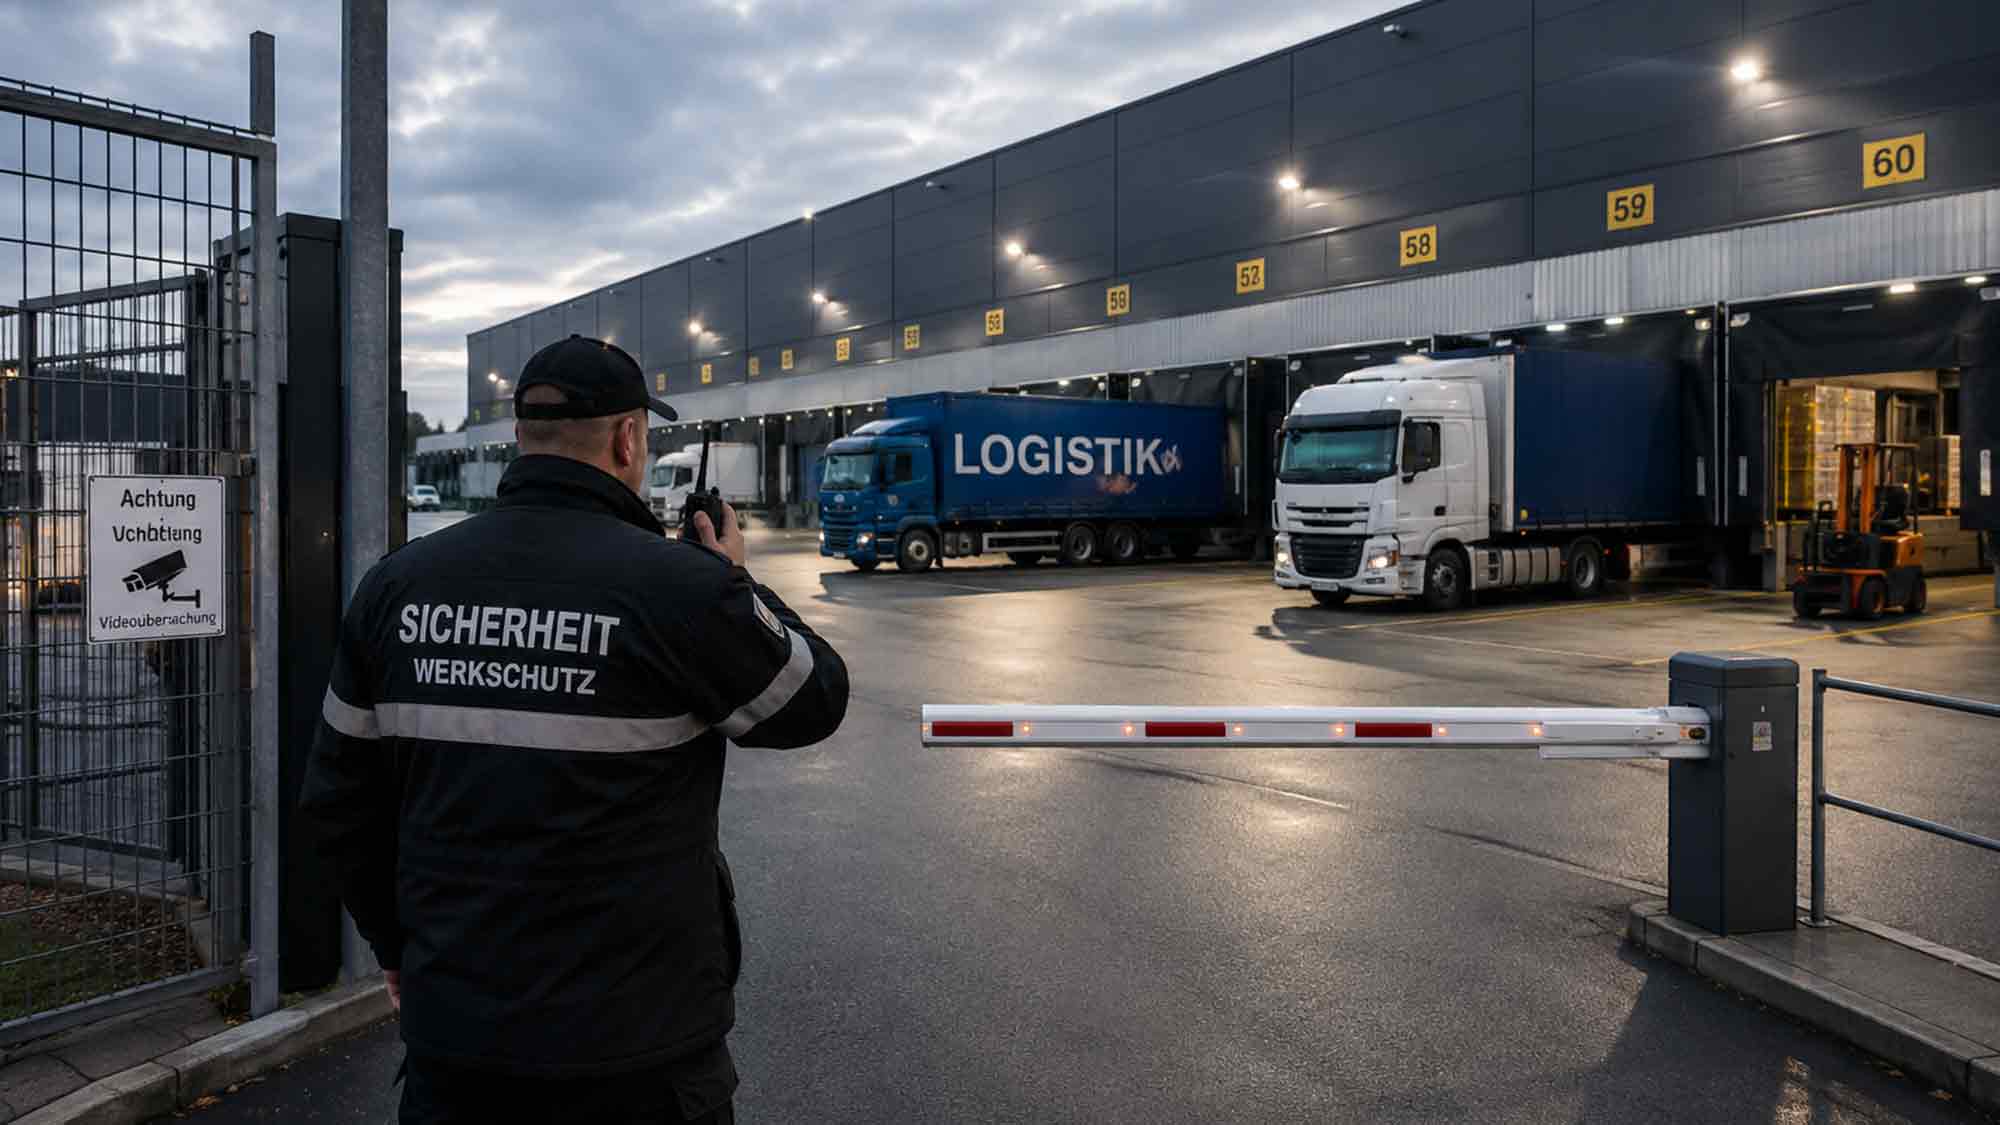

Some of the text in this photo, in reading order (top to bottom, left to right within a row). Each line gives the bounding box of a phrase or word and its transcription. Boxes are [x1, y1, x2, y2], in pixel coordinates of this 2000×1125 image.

[1873, 144, 1915, 177] 60
[1615, 193, 1646, 222] 59
[1406, 233, 1430, 258] 58
[120, 488, 196, 511] Achtung
[399, 603, 620, 656] SICHERHEIT
[413, 657, 597, 695] WERKSCHUTZ
